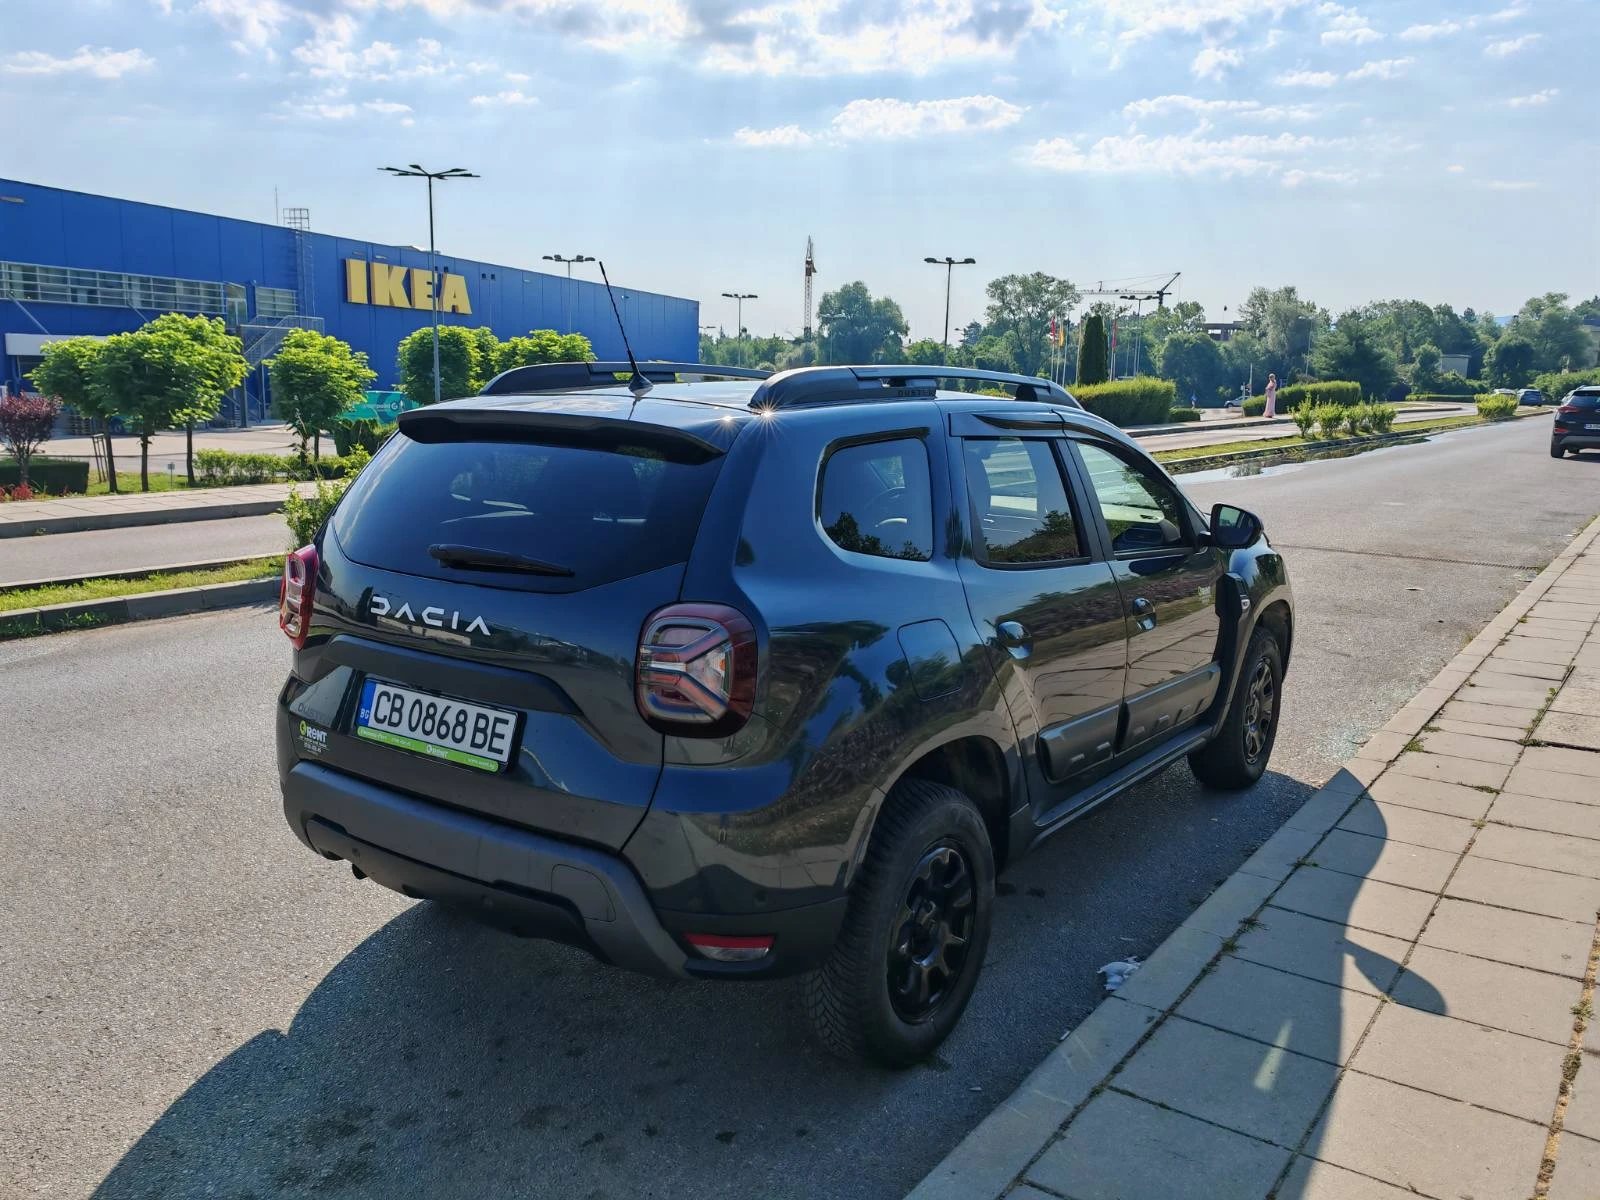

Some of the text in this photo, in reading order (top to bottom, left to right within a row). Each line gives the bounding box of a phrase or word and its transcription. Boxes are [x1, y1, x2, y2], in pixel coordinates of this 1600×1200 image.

[345, 258, 472, 315] IKEA
[370, 596, 491, 636] DACIA
[359, 708, 371, 720] BG
[373, 690, 510, 755] CB 0868 BE
